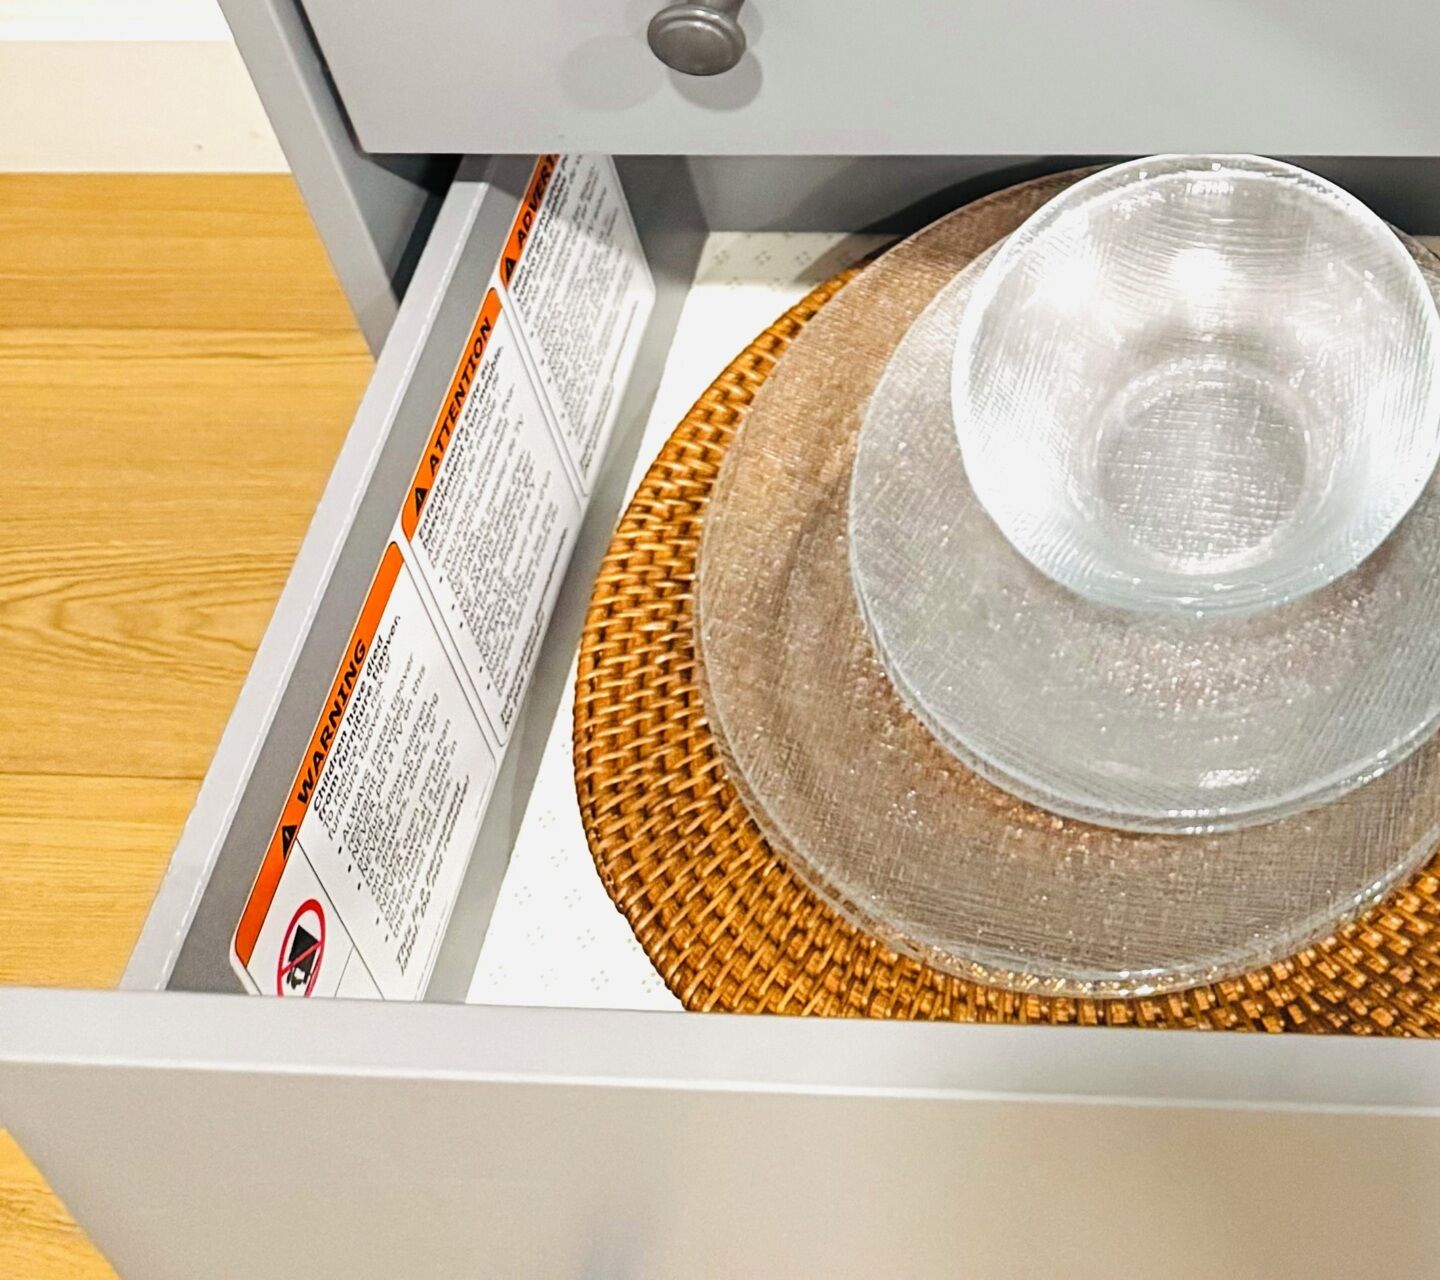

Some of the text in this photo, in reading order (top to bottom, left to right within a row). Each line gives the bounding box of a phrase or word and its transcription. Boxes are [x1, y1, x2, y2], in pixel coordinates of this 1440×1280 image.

[517, 154, 558, 250] ADVERT
[429, 318, 490, 474] ATTENTION
[298, 640, 364, 802] WARNING
[313, 635, 382, 810] Children have died
[318, 774, 338, 820] from
[338, 685, 371, 768] furniture
[322, 655, 390, 827] To reduce the risk of
[328, 764, 358, 840] furniture
[342, 655, 412, 842] ALWAYS install tipover
[351, 666, 425, 860] NEVER put a TV on this
[360, 701, 427, 877] NEVER allow children
[365, 868, 374, 886] to
[396, 759, 413, 804] climb
[413, 737, 421, 755] or
[420, 692, 438, 733] hang
[371, 873, 380, 895] on
[429, 715, 436, 733] or
[347, 776, 375, 850] restraint
[379, 719, 450, 912] NEVER open more than
